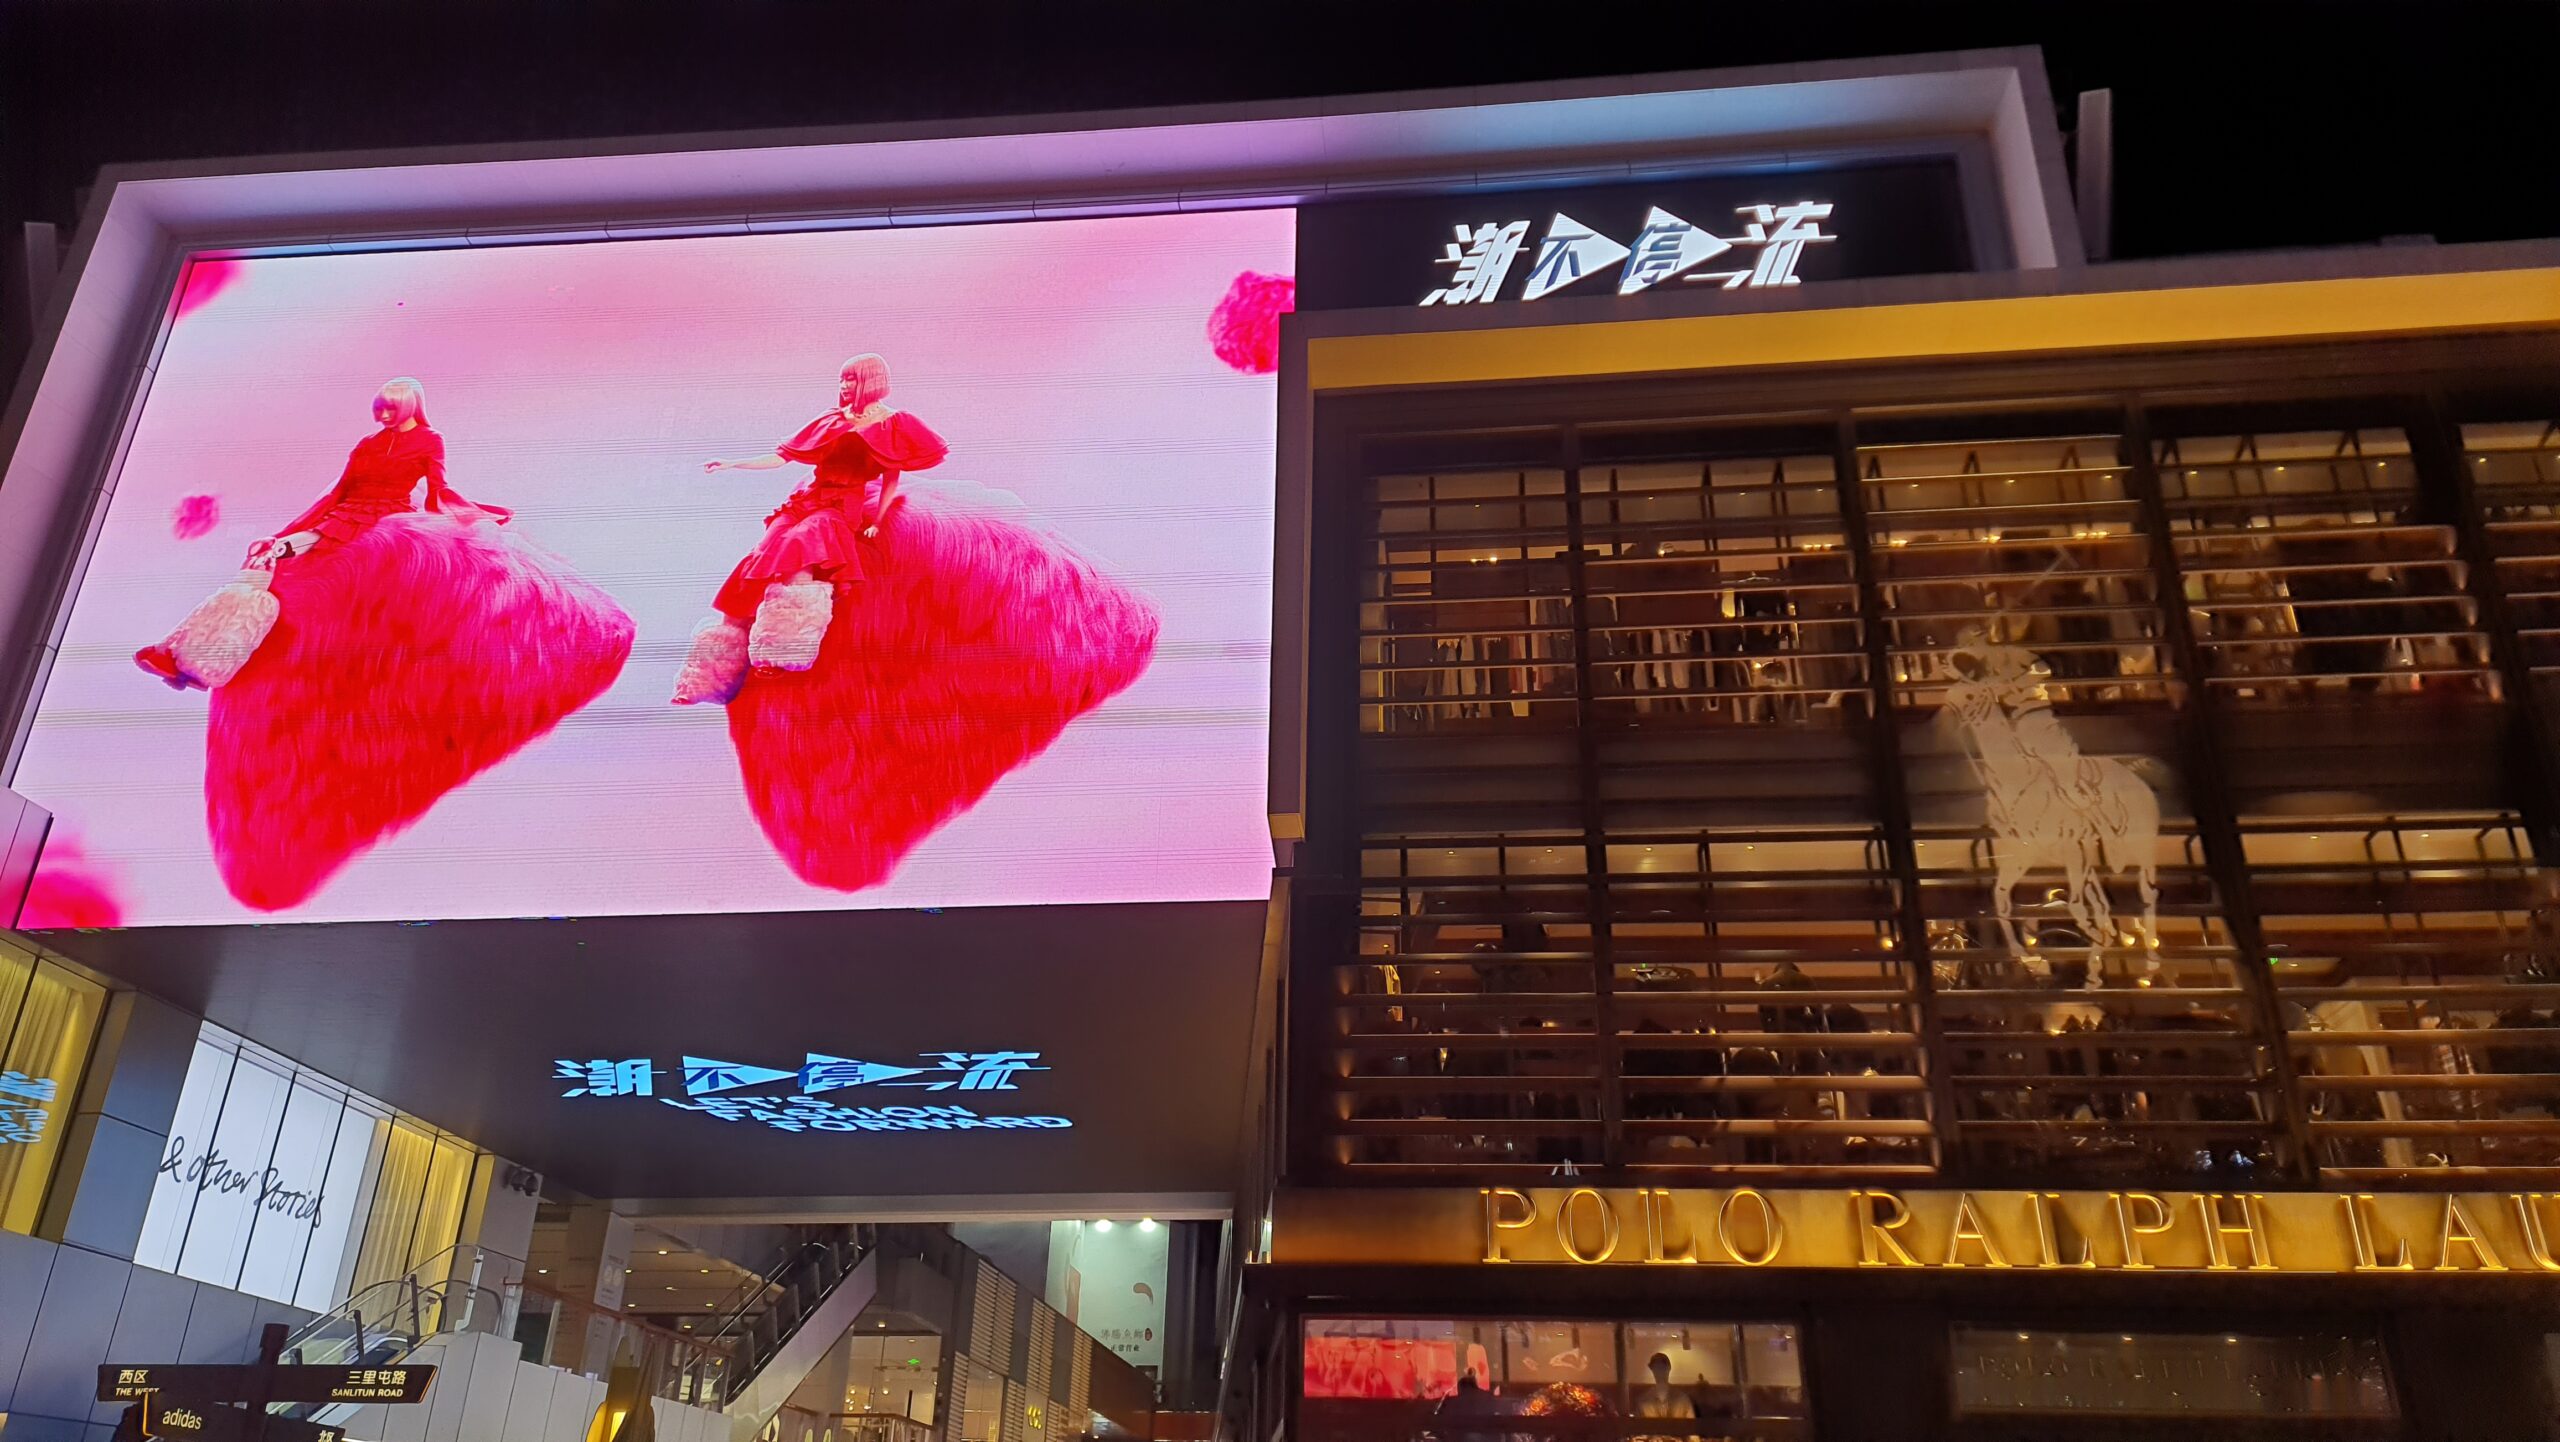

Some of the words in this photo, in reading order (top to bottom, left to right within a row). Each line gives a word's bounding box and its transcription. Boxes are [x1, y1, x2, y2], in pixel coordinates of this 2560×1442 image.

[659, 1096, 835, 1111] LET'S
[706, 1105, 978, 1122] FASHION
[767, 1116, 1073, 1132] FORWARD
[159, 1136, 185, 1183] &
[187, 1149, 258, 1195] other
[254, 1167, 325, 1229] Stories
[1480, 1189, 1784, 1267] POLO
[1850, 1191, 2279, 1269] RALPH
[118, 1369, 149, 1384] 西区
[346, 1370, 407, 1385] 三里屯路
[115, 1387, 133, 1396] THE
[331, 1388, 375, 1397] SANLITUN
[377, 1388, 404, 1397] ROAD
[162, 1408, 202, 1430] adidas
